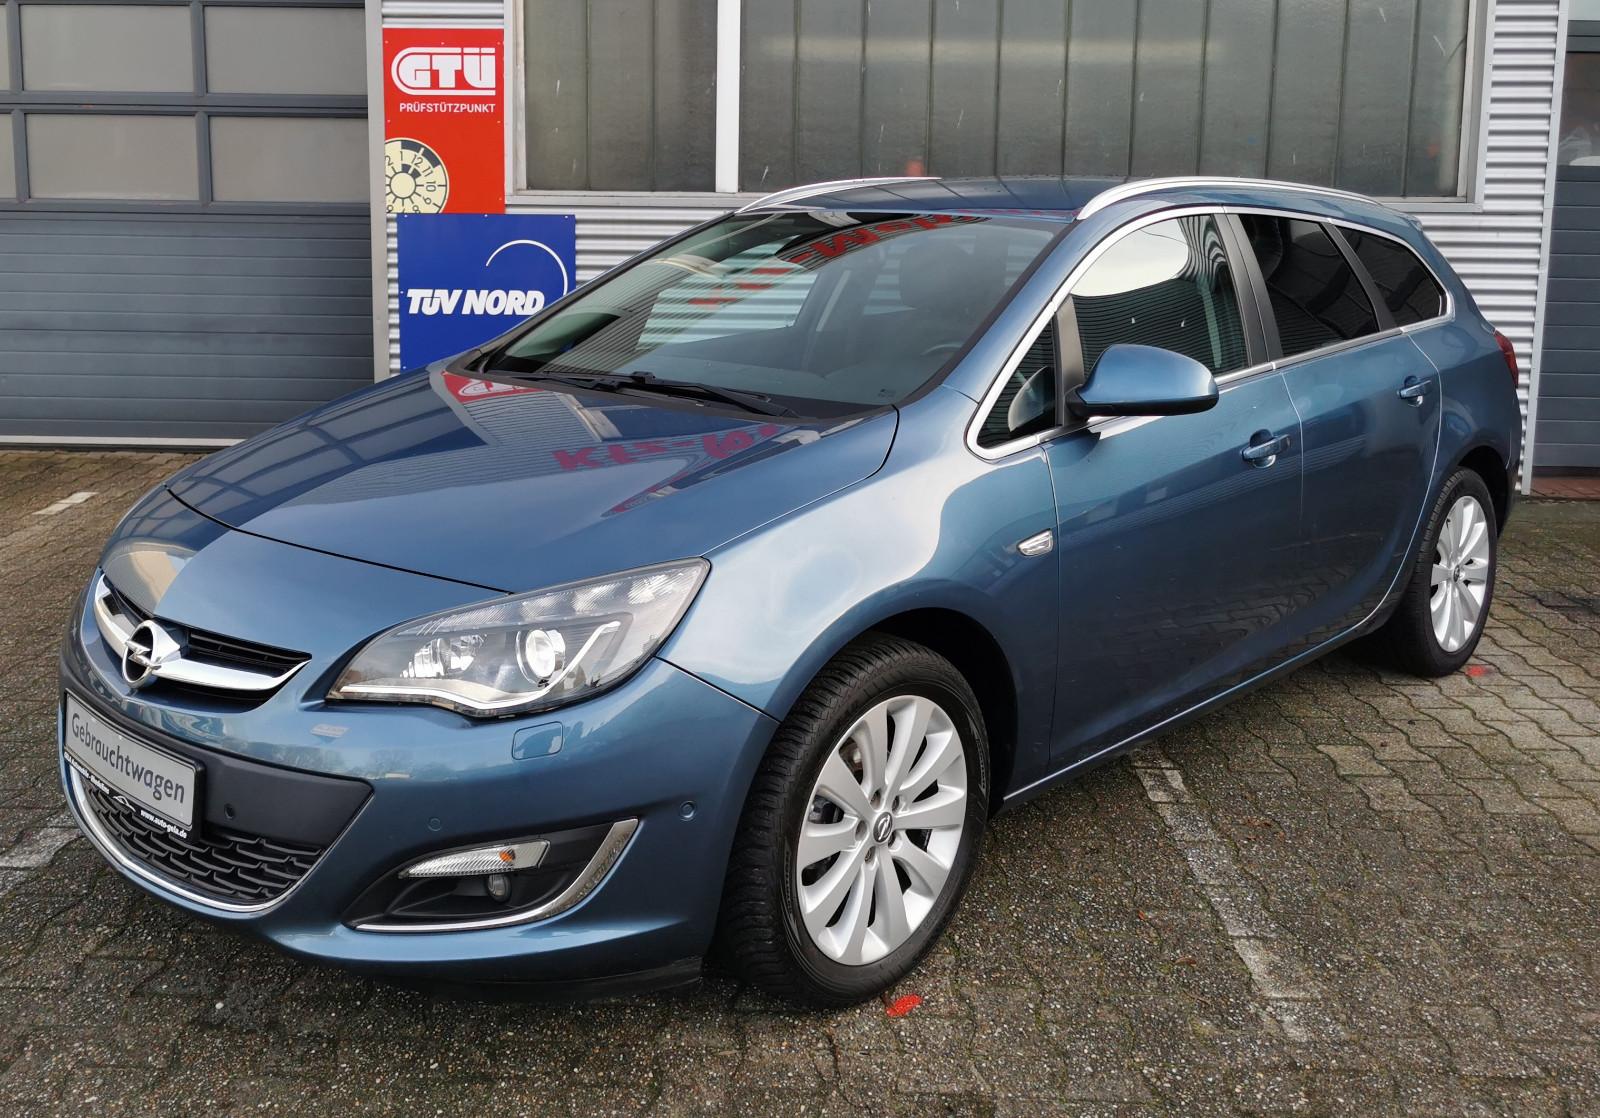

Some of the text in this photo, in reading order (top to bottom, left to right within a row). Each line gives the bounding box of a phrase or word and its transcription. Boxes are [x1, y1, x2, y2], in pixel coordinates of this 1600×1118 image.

[391, 47, 496, 95] GTÜ
[400, 101, 496, 113] PRÜFSTÜTZPUNKT
[411, 154, 423, 168] 12
[422, 166, 433, 177] 11
[426, 181, 436, 192] 10
[406, 288, 545, 316] TÜV NORD
[72, 712, 186, 805] Gebrauchtwagen
